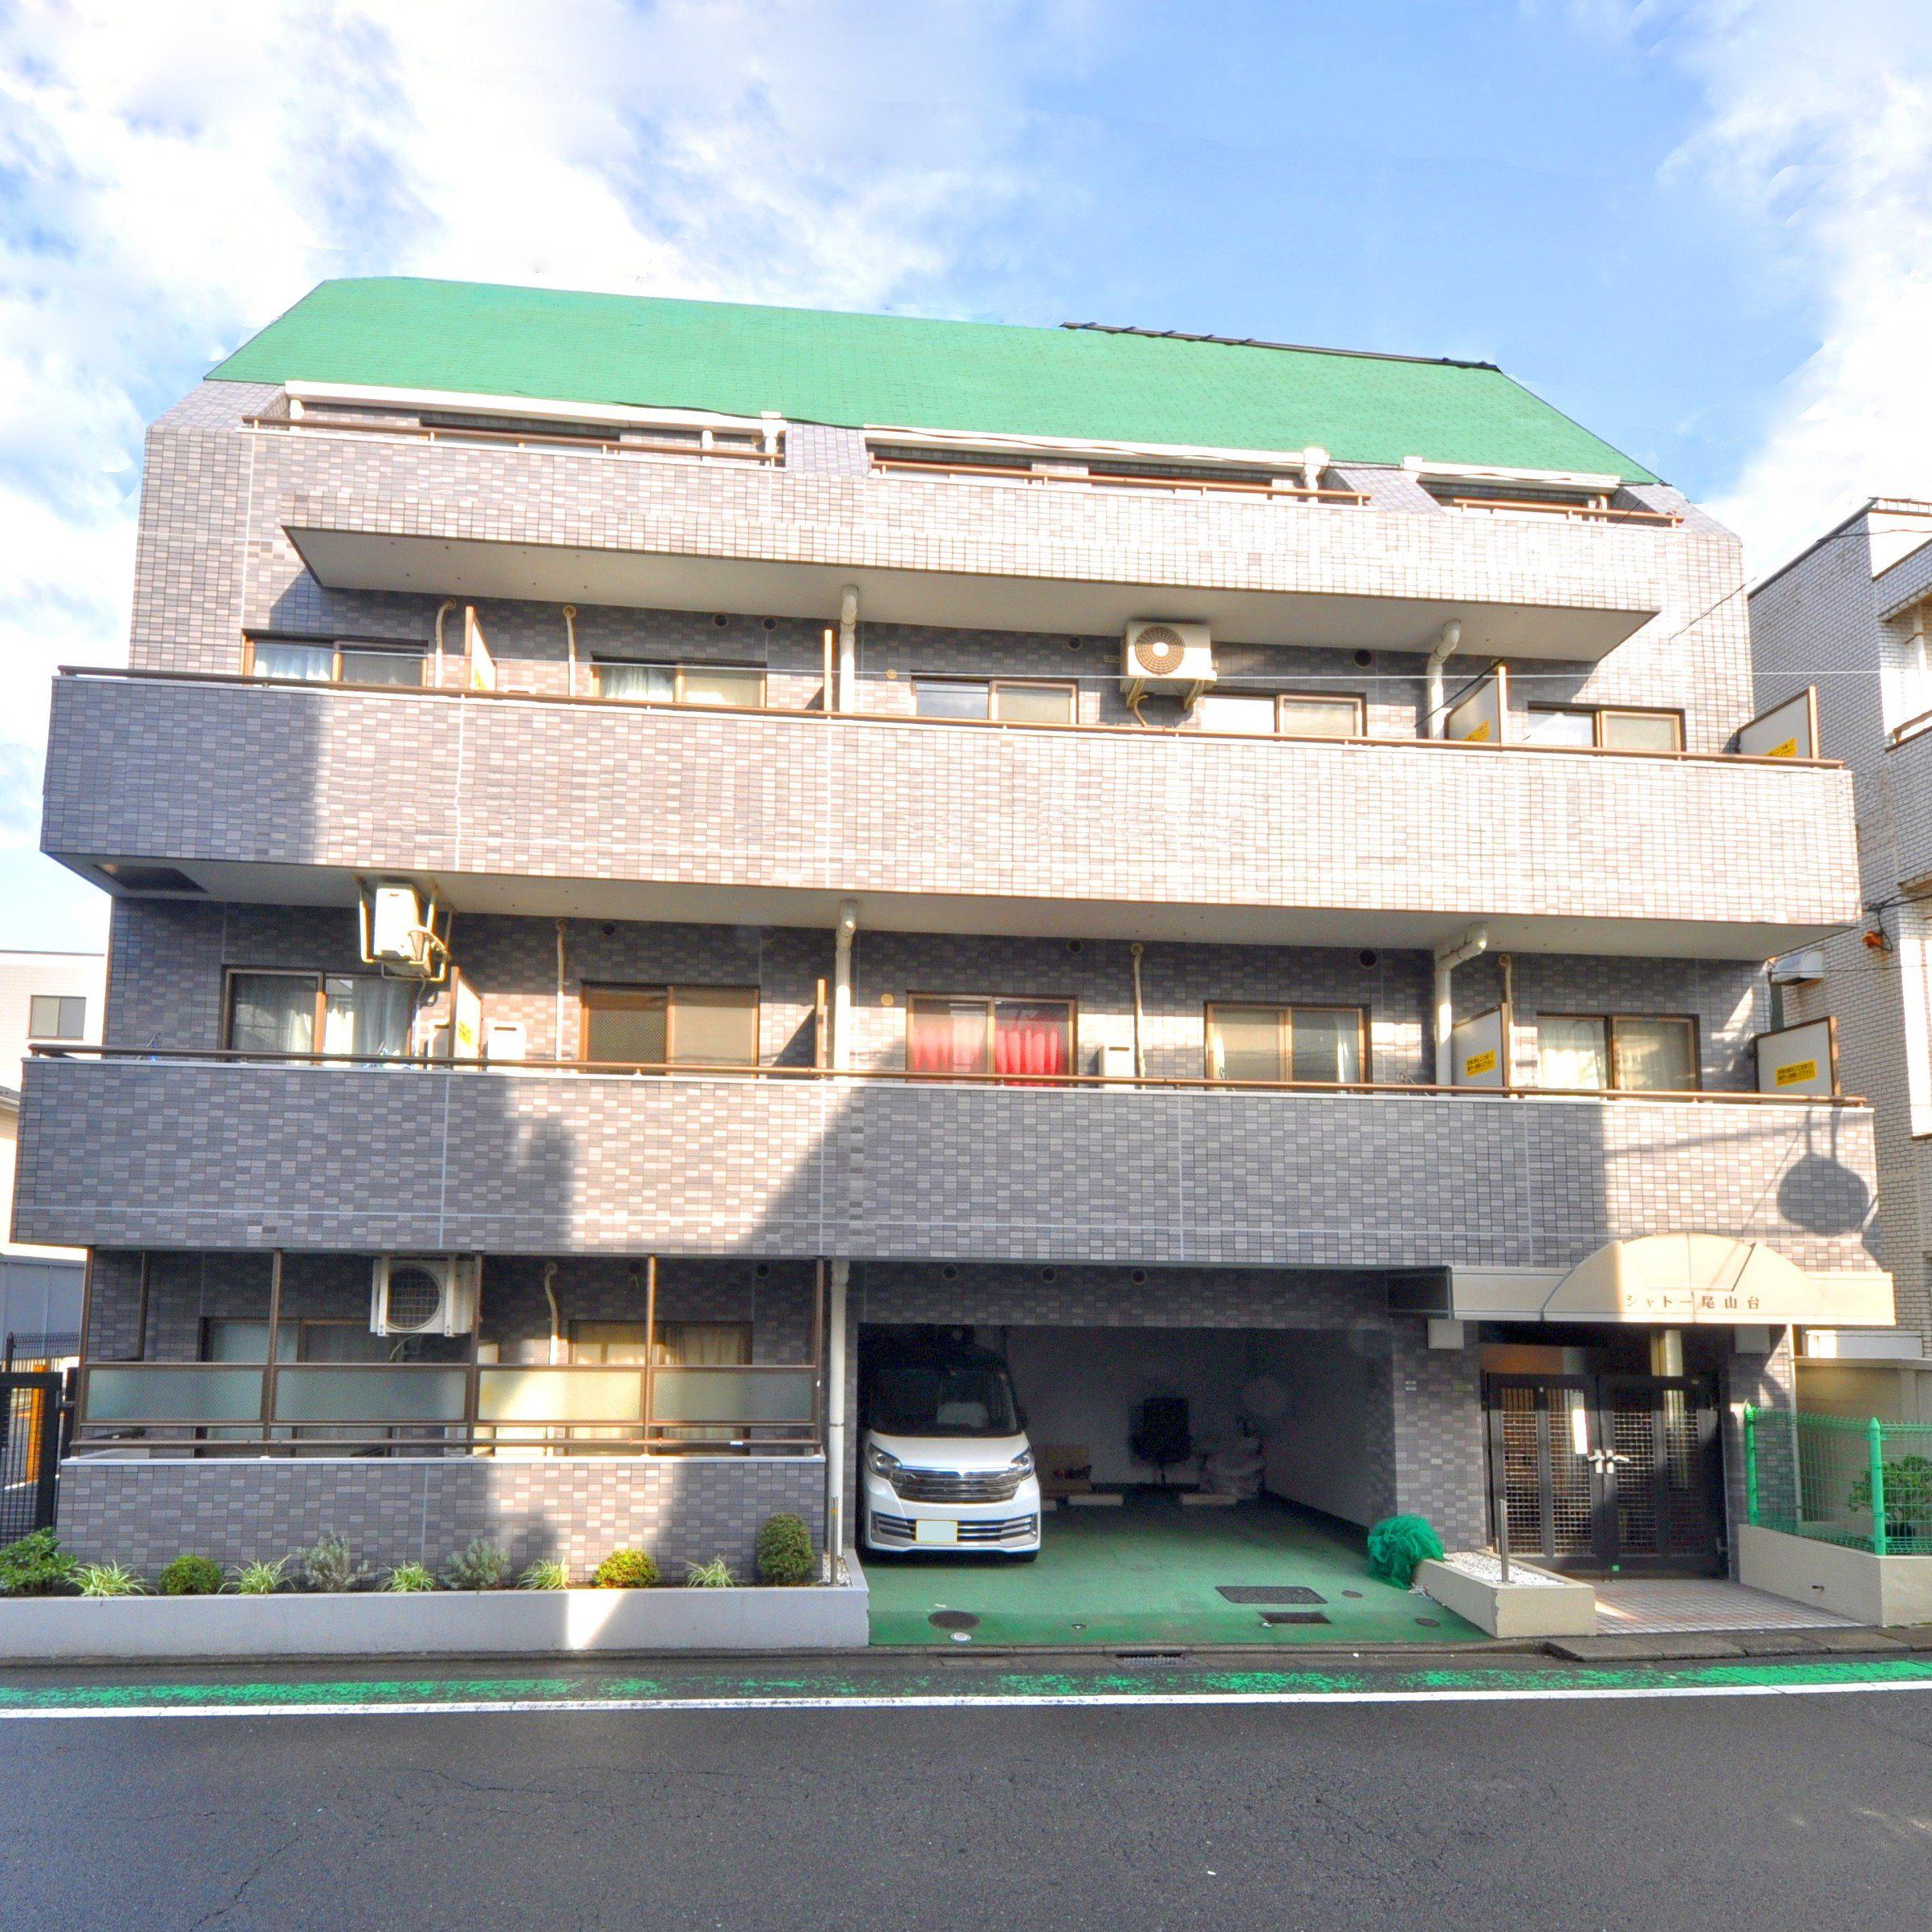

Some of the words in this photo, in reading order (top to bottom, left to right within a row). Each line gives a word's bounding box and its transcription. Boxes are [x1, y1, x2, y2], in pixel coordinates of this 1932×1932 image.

[1626, 1295, 1759, 1310] シャトー尾山台
